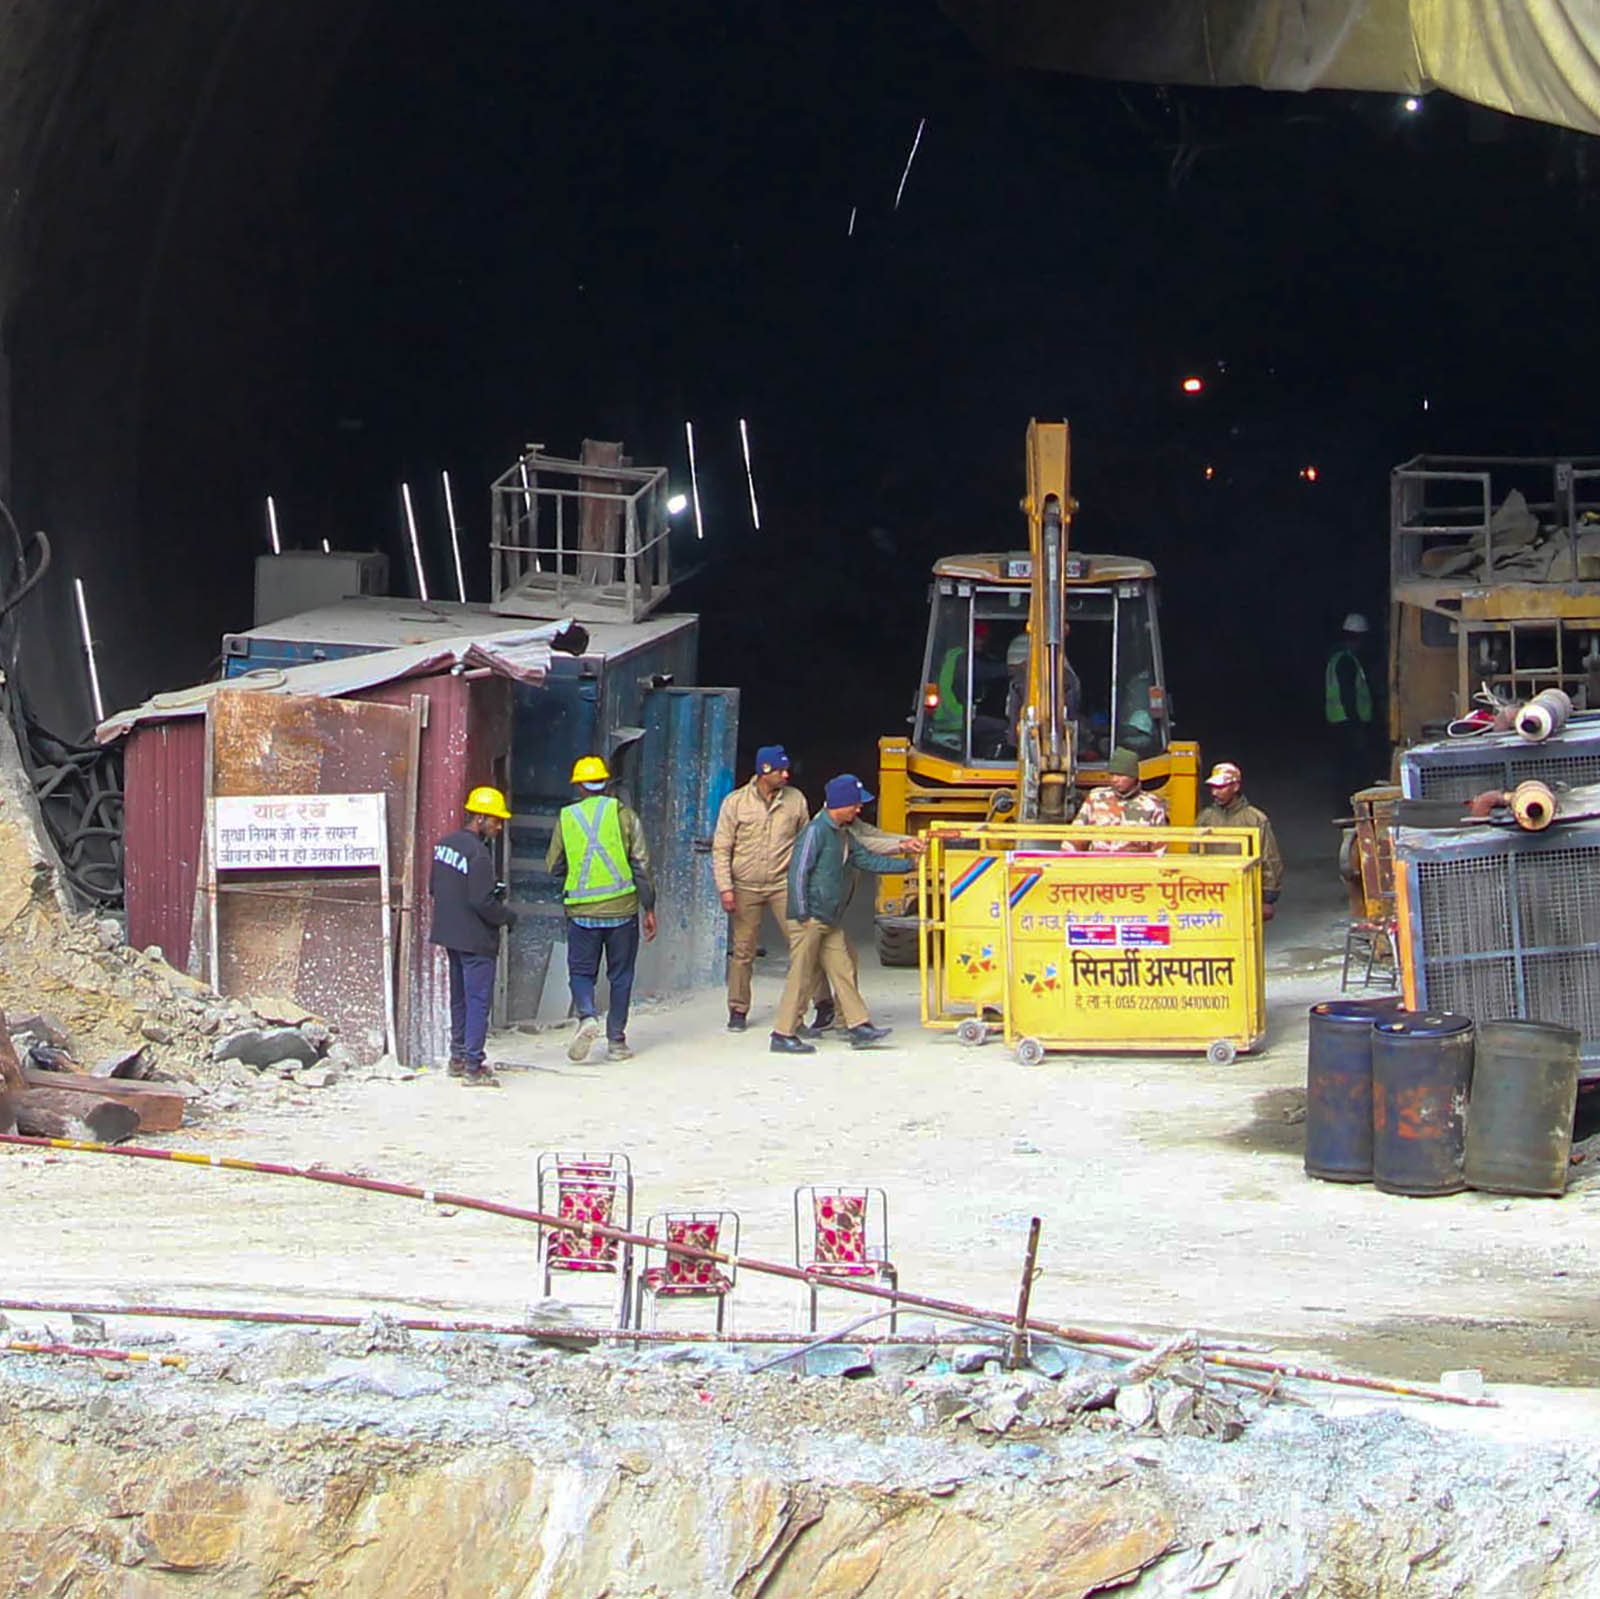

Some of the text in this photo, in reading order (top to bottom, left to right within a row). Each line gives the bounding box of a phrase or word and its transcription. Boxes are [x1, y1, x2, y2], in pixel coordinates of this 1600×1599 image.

[1047, 874, 1229, 911] उत्तराखण्ड पुलिस
[1071, 948, 1235, 988] सिनर्जी अस्पताल
